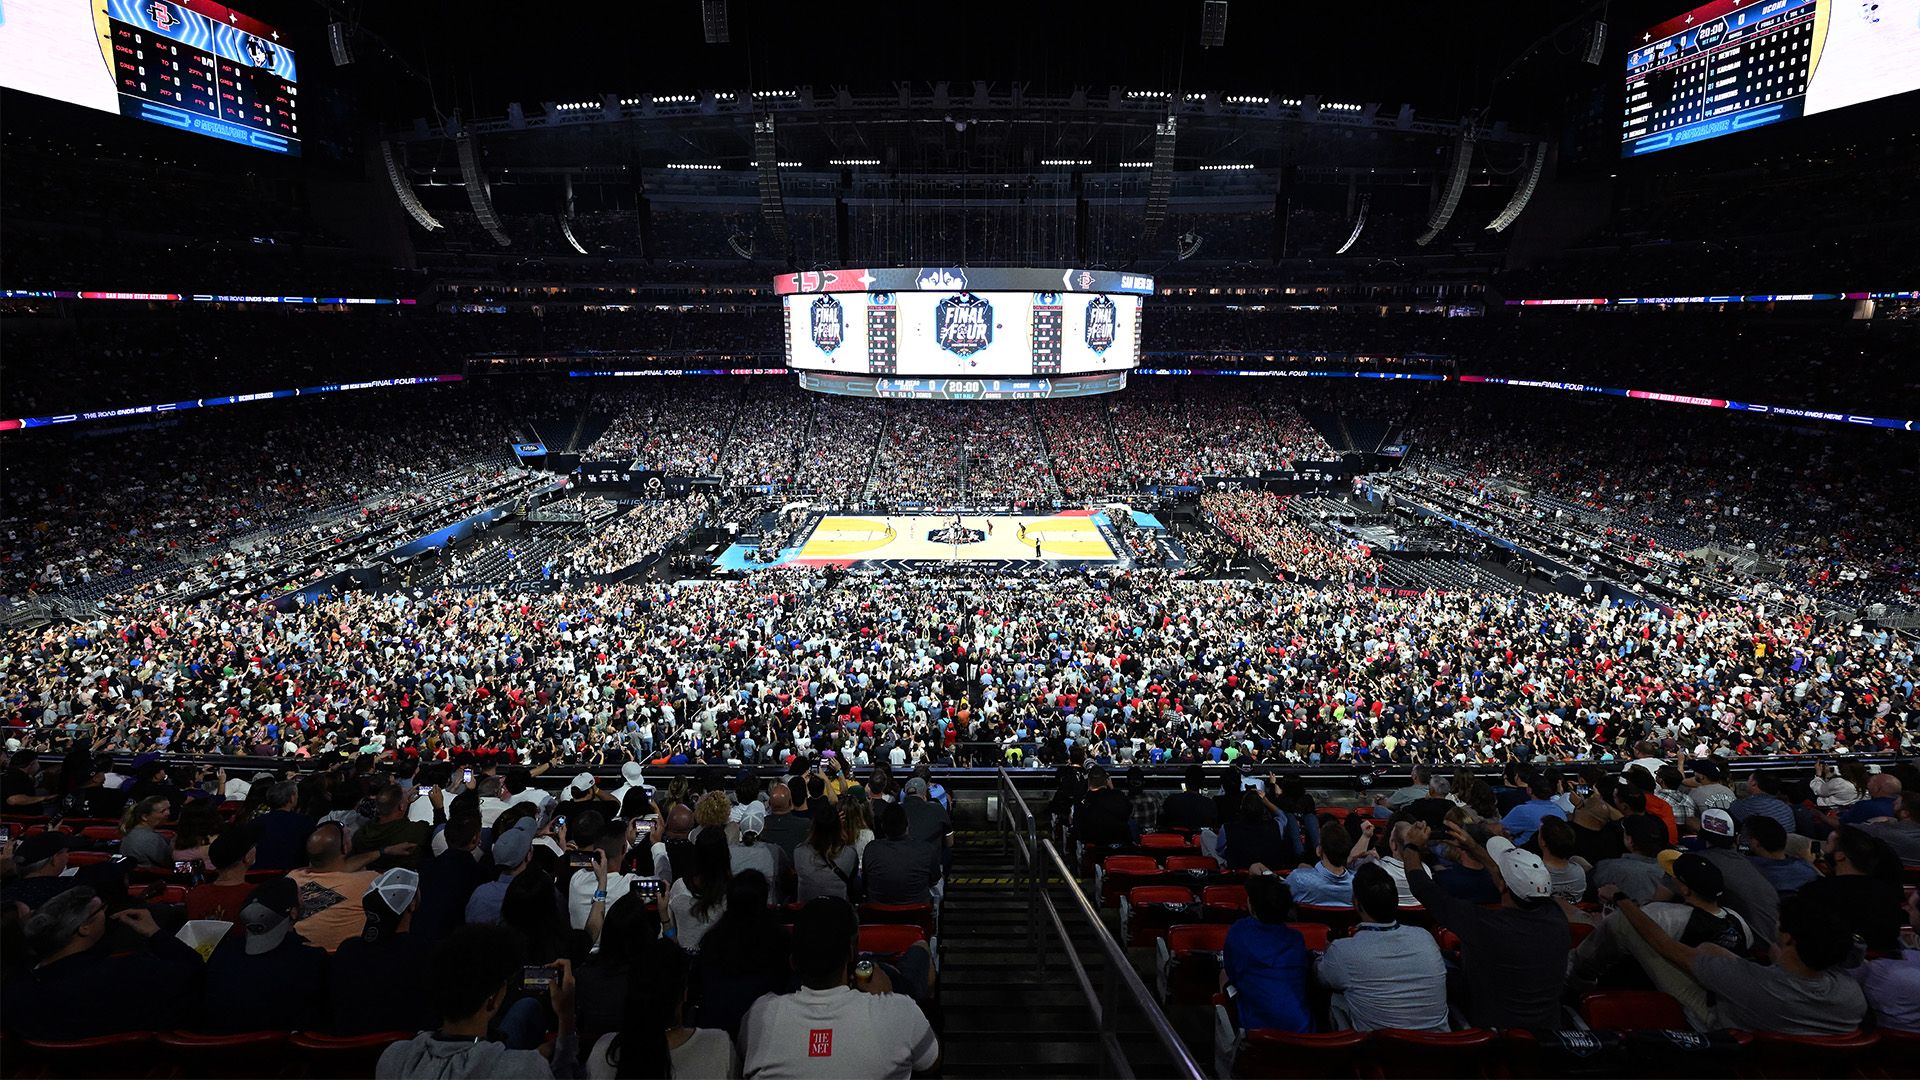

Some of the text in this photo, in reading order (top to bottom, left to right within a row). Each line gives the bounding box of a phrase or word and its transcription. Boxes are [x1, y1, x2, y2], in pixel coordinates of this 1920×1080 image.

[1738, 0, 1787, 25] 0 UCONN
[1700, 22, 1723, 39] 20:00
[135, 34, 141, 43] 0
[1681, 36, 1686, 46] 0
[137, 50, 143, 60] 0
[171, 46, 177, 55] 0
[139, 66, 145, 75] 0
[173, 62, 178, 71] 0
[140, 82, 146, 91] 0
[174, 77, 180, 86] 0
[176, 92, 181, 101] 0
[816, 308, 838, 322] FINAL
[946, 307, 984, 323] FINAL
[1091, 308, 1112, 322] FINAL
[818, 322, 840, 337] FOUR
[949, 324, 987, 340] FOUR
[1092, 324, 1113, 338] FOUR
[929, 380, 935, 390] 0
[949, 382, 979, 392] 20:00
[993, 381, 999, 390] 0
[813, 1044, 829, 1053] MET
